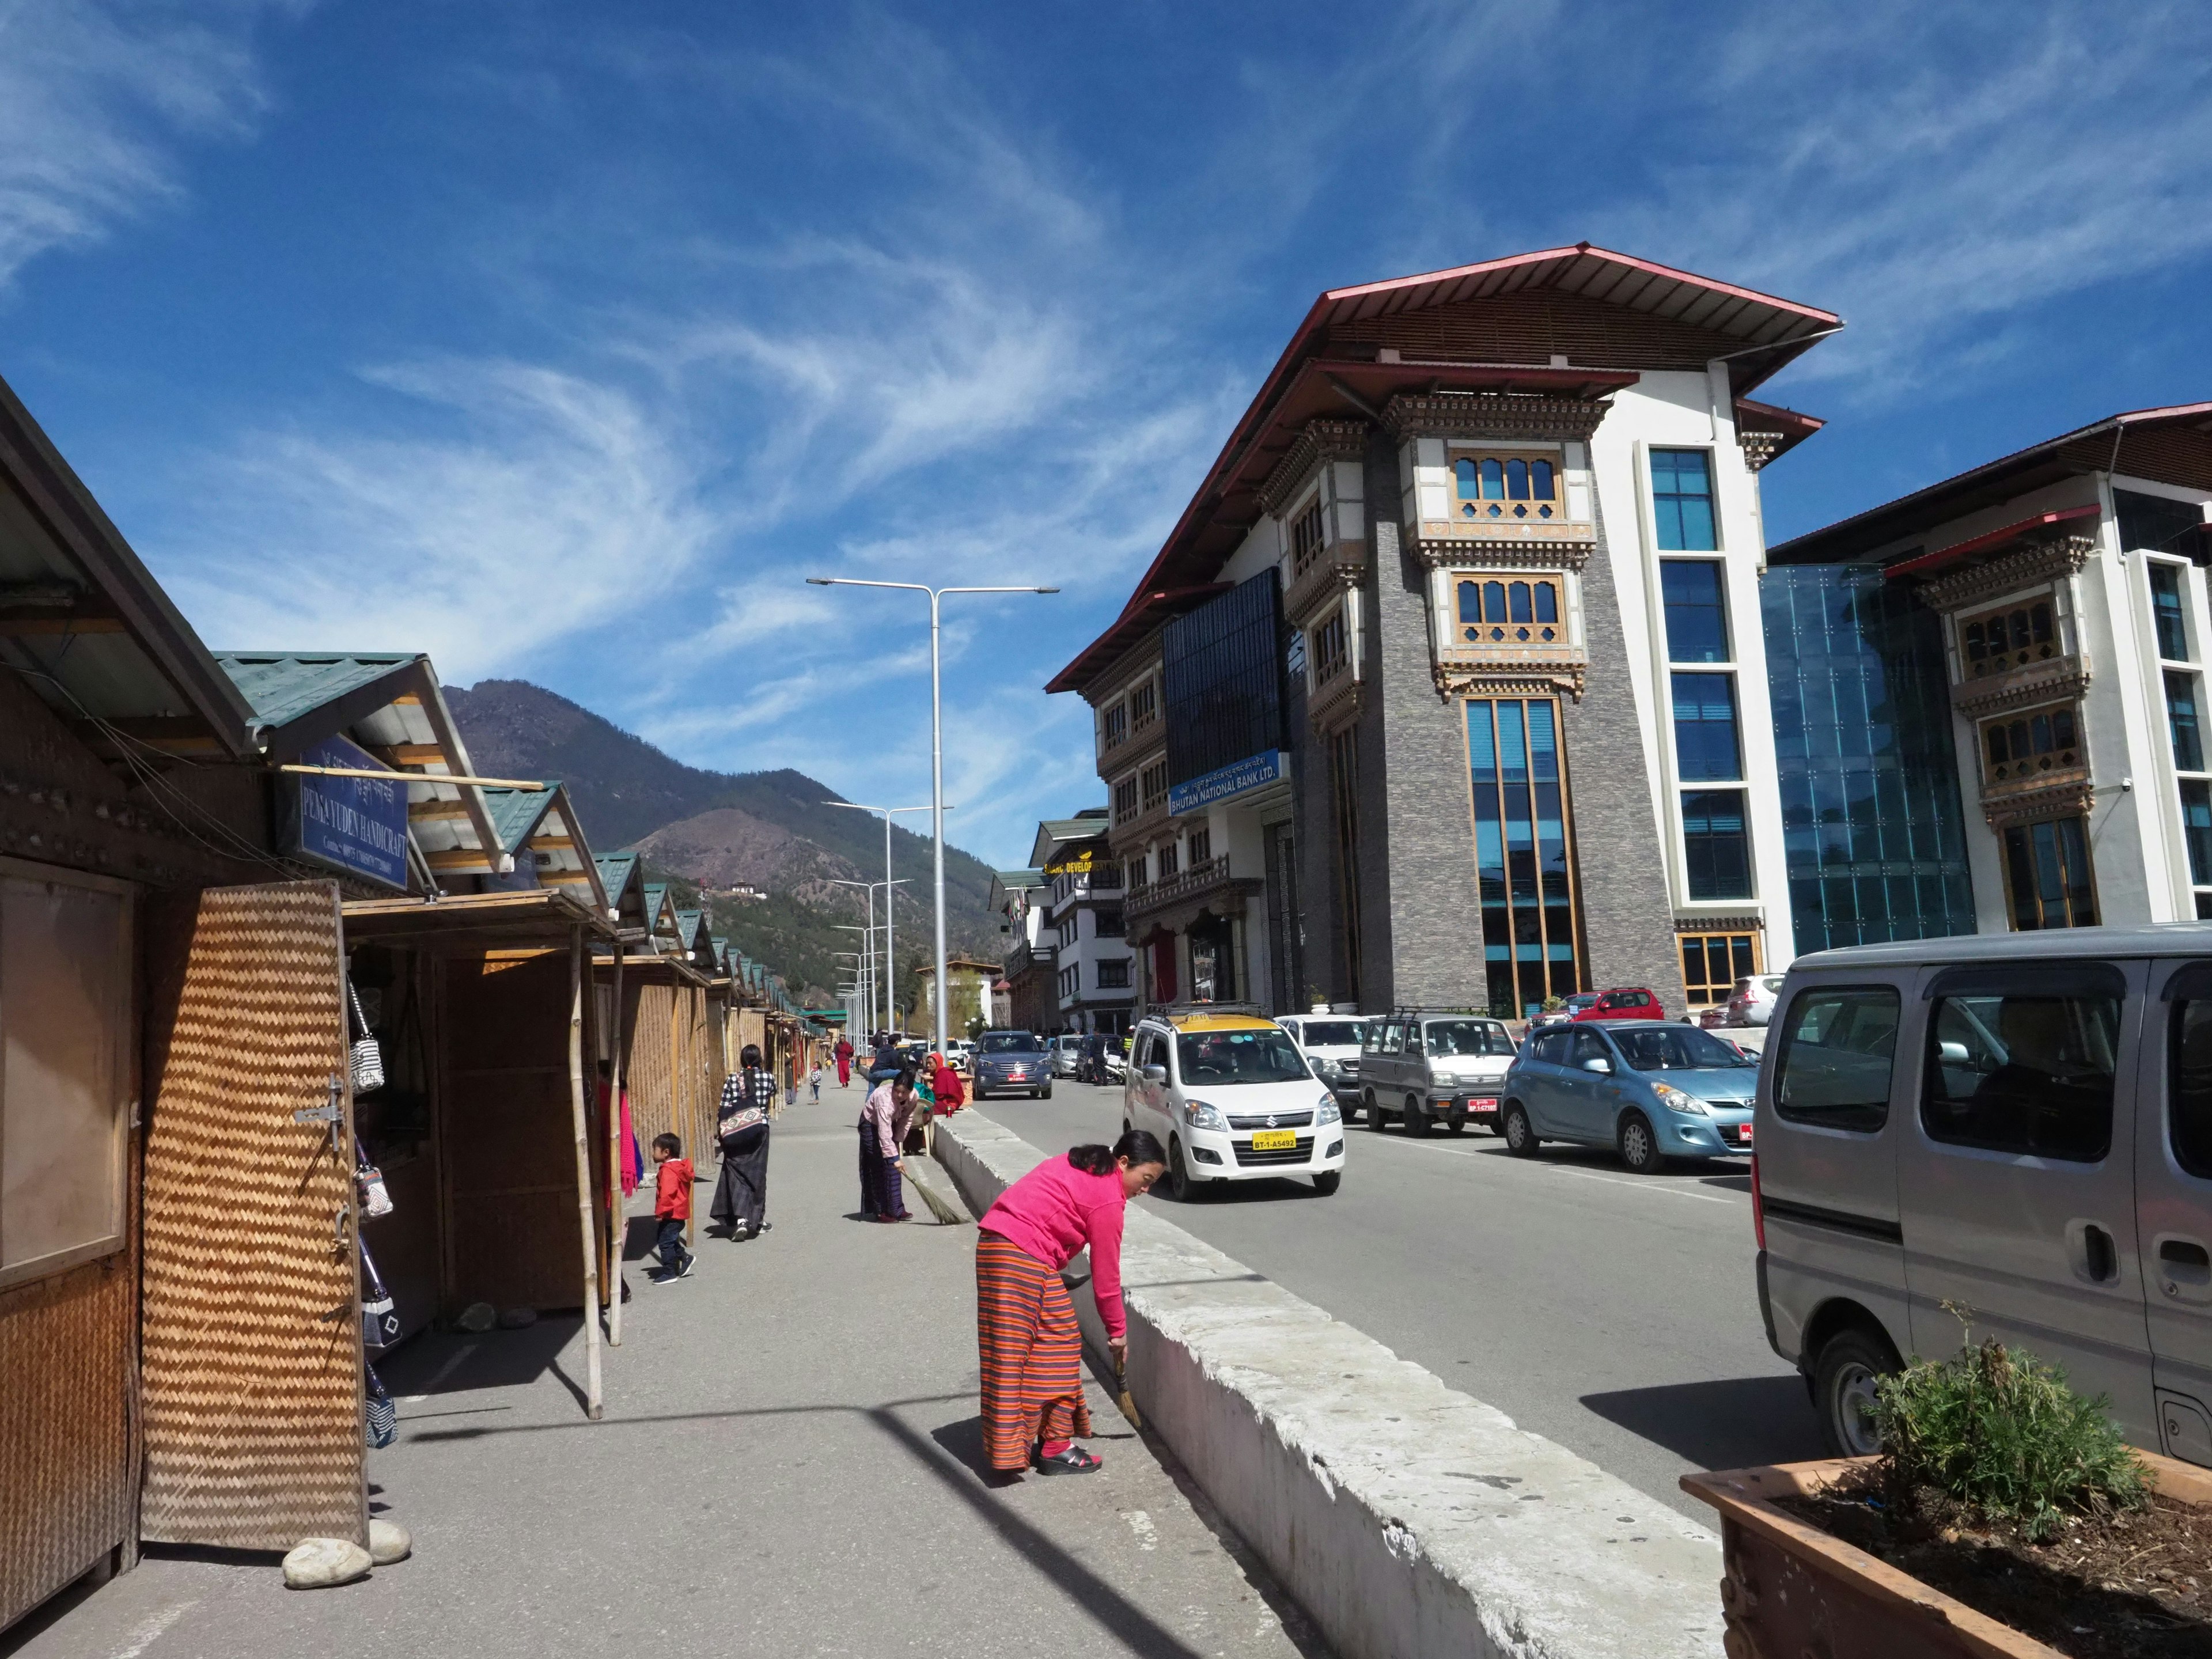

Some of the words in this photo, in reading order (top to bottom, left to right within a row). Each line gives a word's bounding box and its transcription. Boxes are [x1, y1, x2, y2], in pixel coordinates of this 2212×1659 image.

[1171, 793, 1199, 812] BHUTAN
[1200, 779, 1236, 802] NATIONAL
[1237, 771, 1259, 789] BANK
[1259, 766, 1276, 781] LTD.
[303, 786, 330, 826] PEMA
[330, 798, 359, 838] YUDEN
[360, 814, 406, 859] HANDICRAFT
[1255, 1139, 1294, 1149] BT-1-A5492
